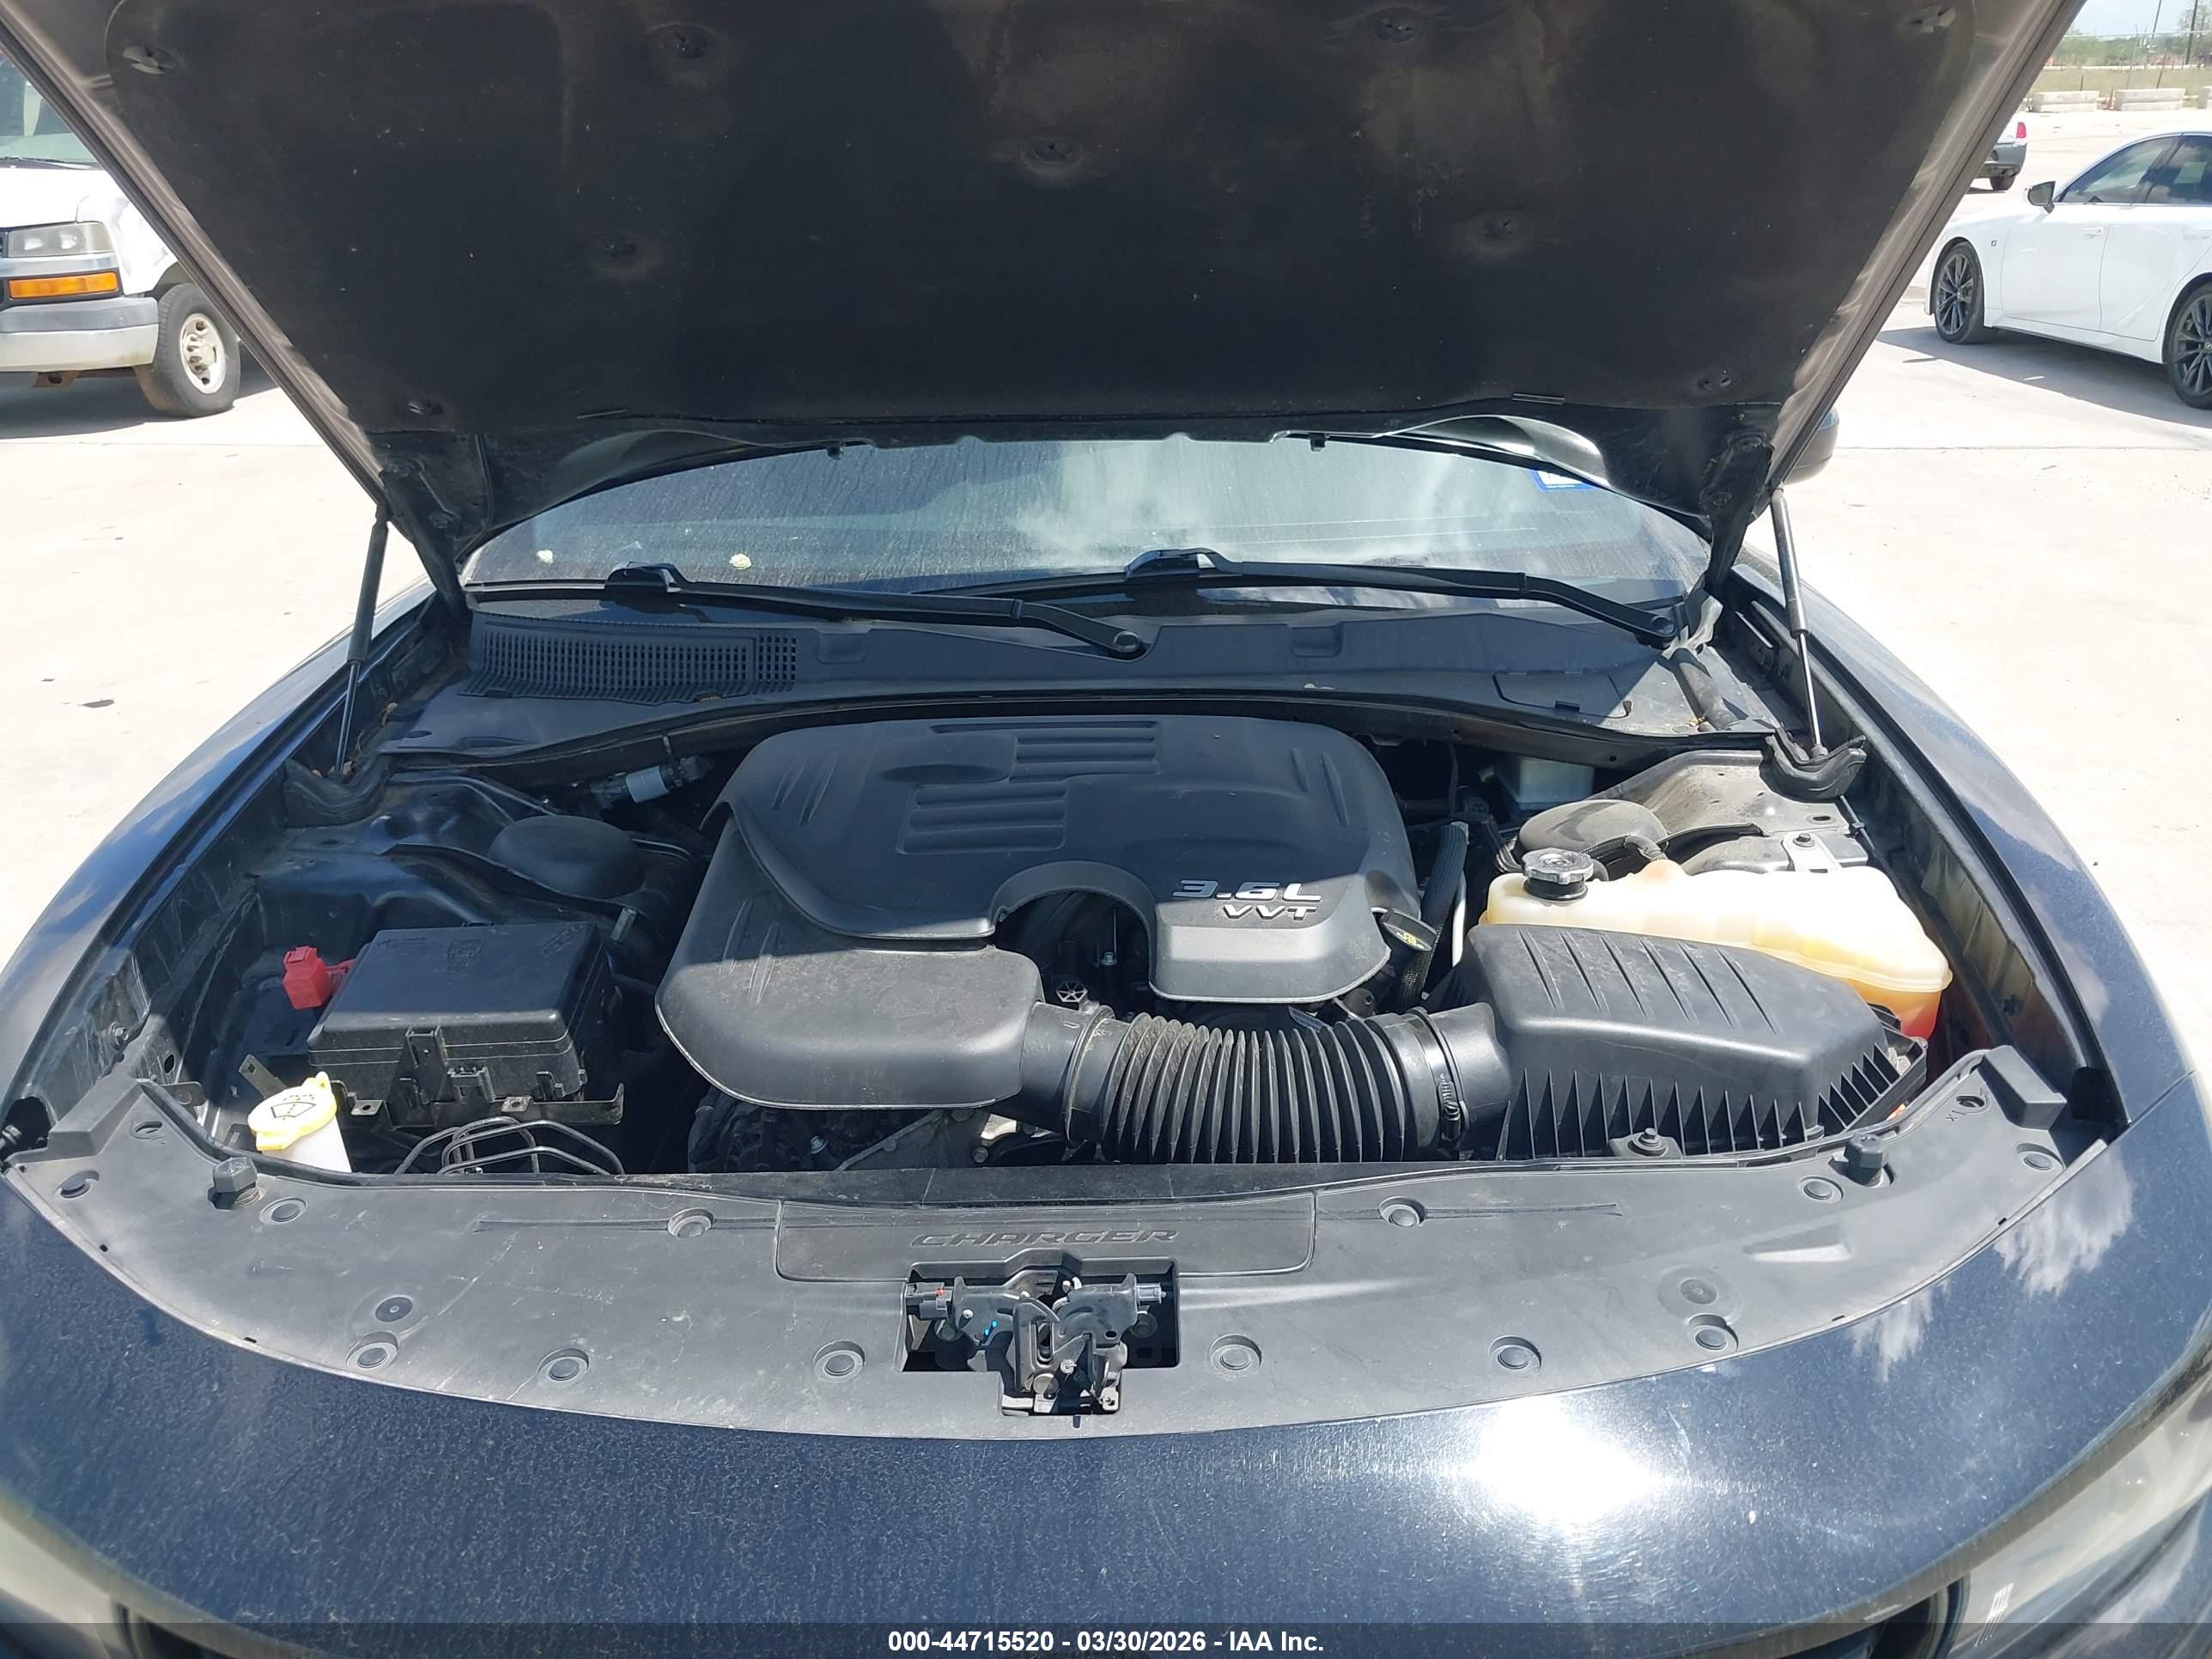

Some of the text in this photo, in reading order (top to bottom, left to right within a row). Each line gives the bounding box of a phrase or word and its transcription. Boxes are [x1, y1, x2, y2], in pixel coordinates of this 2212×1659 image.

[1172, 879, 1322, 902] 3.6L
[1223, 904, 1317, 921] VVT
[910, 1229, 1180, 1247] CHARGER
